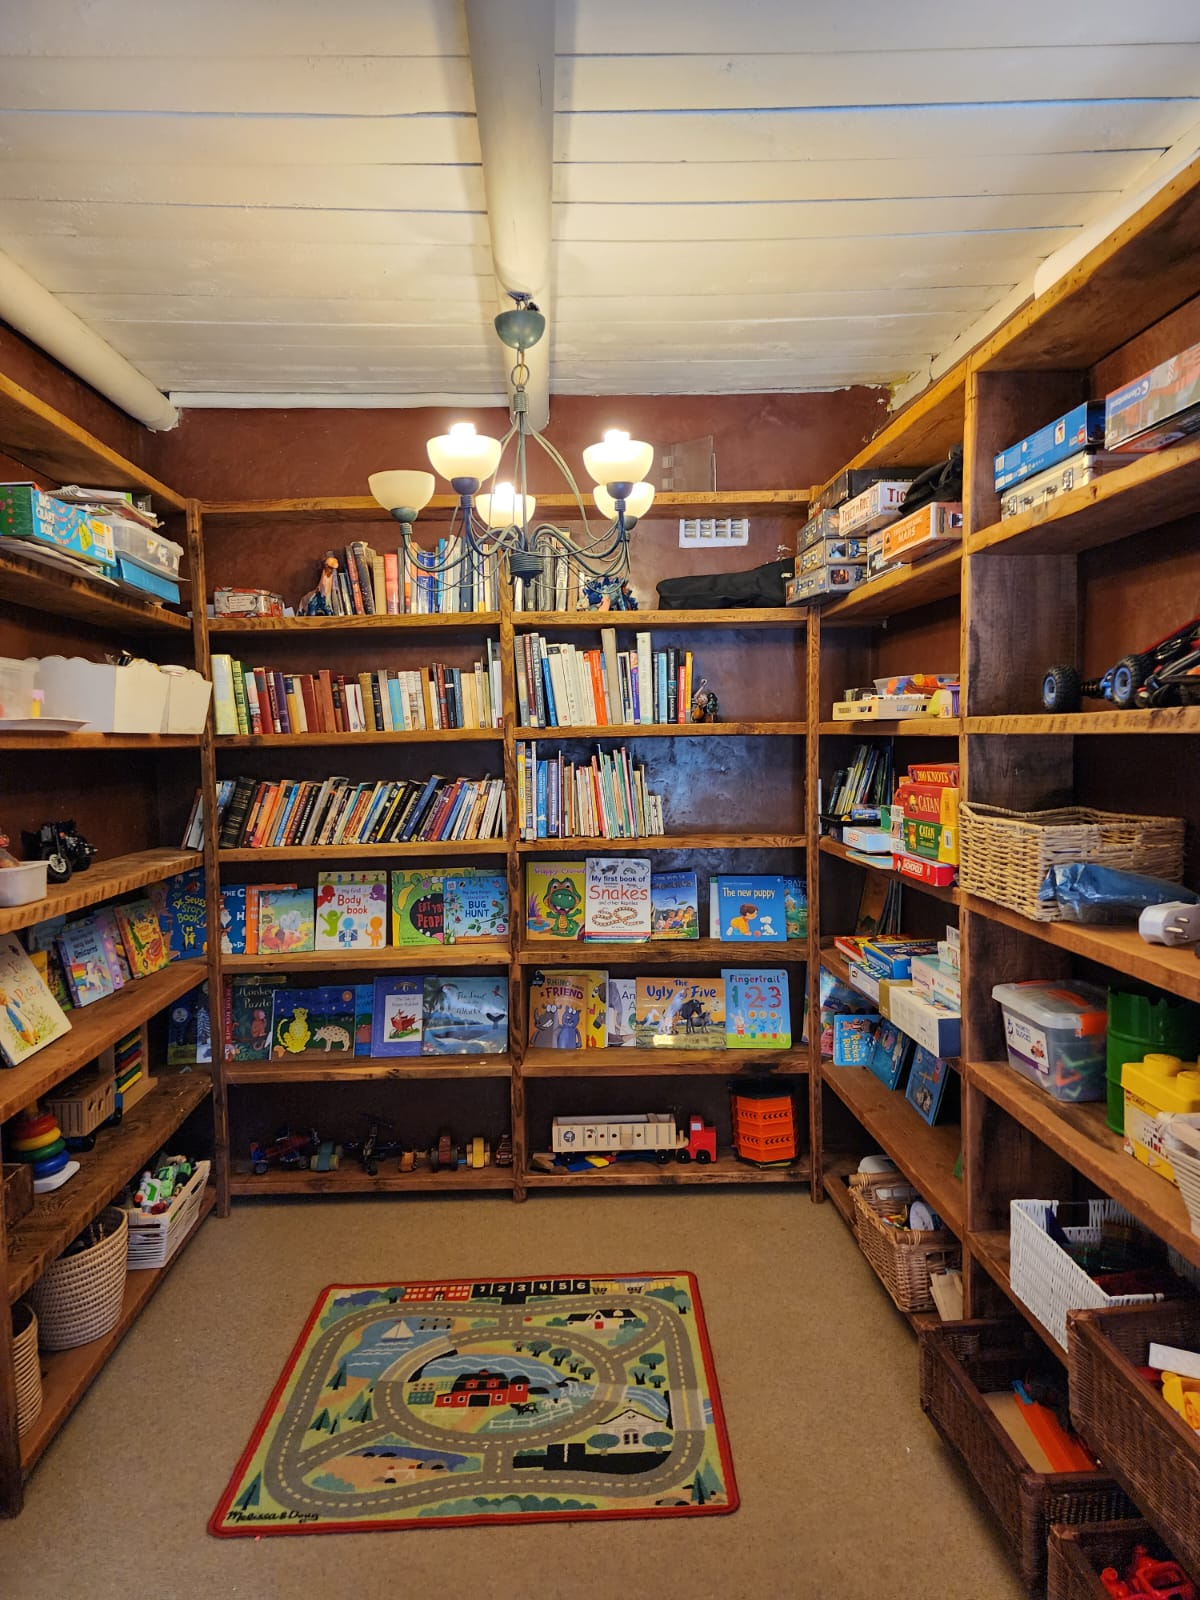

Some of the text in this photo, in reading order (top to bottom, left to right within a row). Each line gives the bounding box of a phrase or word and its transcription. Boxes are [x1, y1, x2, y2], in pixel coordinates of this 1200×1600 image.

[887, 487, 906, 503] TIC
[927, 771, 949, 784] KNOTS
[918, 795, 940, 814] CATAN
[920, 824, 935, 840] CATAN
[236, 888, 246, 897] C
[589, 885, 648, 900] Snakes
[722, 887, 736, 897] The
[753, 889, 776, 899] puppy
[337, 895, 361, 906] Body
[468, 900, 486, 909] BUG
[346, 906, 368, 914] book
[465, 909, 490, 918] HUNT
[674, 979, 689, 987] The
[730, 974, 780, 985] Fingertrail
[546, 986, 584, 1000] FRIEND
[646, 985, 717, 1000] Ugly Five
[538, 1283, 547, 1291] 4
[576, 1282, 585, 1290] 6
[227, 1511, 278, 1523] Melissa
[288, 1511, 319, 1521] Doug
